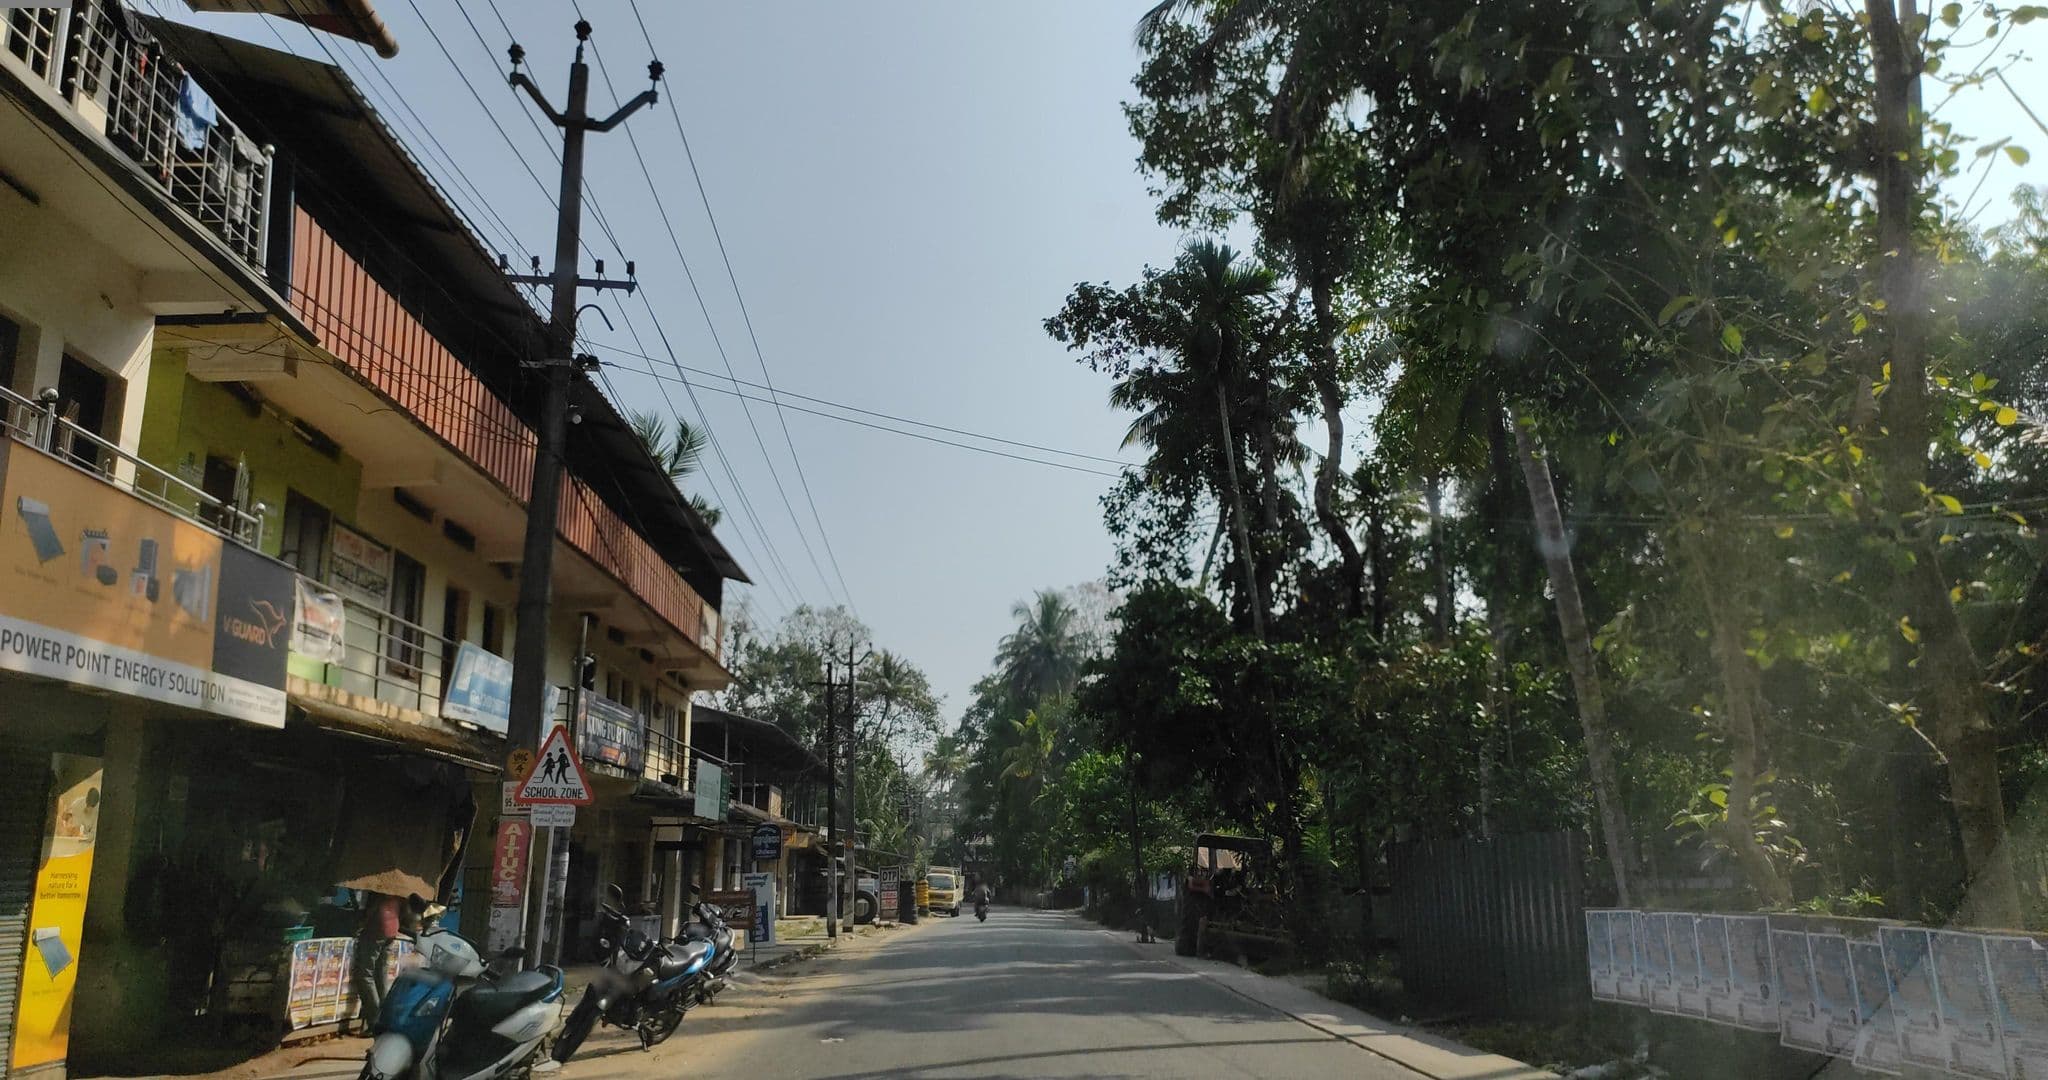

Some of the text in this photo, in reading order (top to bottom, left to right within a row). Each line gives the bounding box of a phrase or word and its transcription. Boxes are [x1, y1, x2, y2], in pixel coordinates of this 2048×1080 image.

[1, 628, 62, 665] POWER
[65, 645, 111, 675] POINT
[114, 657, 166, 691] ENERGY
[168, 671, 226, 703] SOLUTION
[524, 786, 584, 799] SCHOOL ZONE
[499, 823, 522, 881] AITUC
[50, 871, 79, 880] Harnessing
